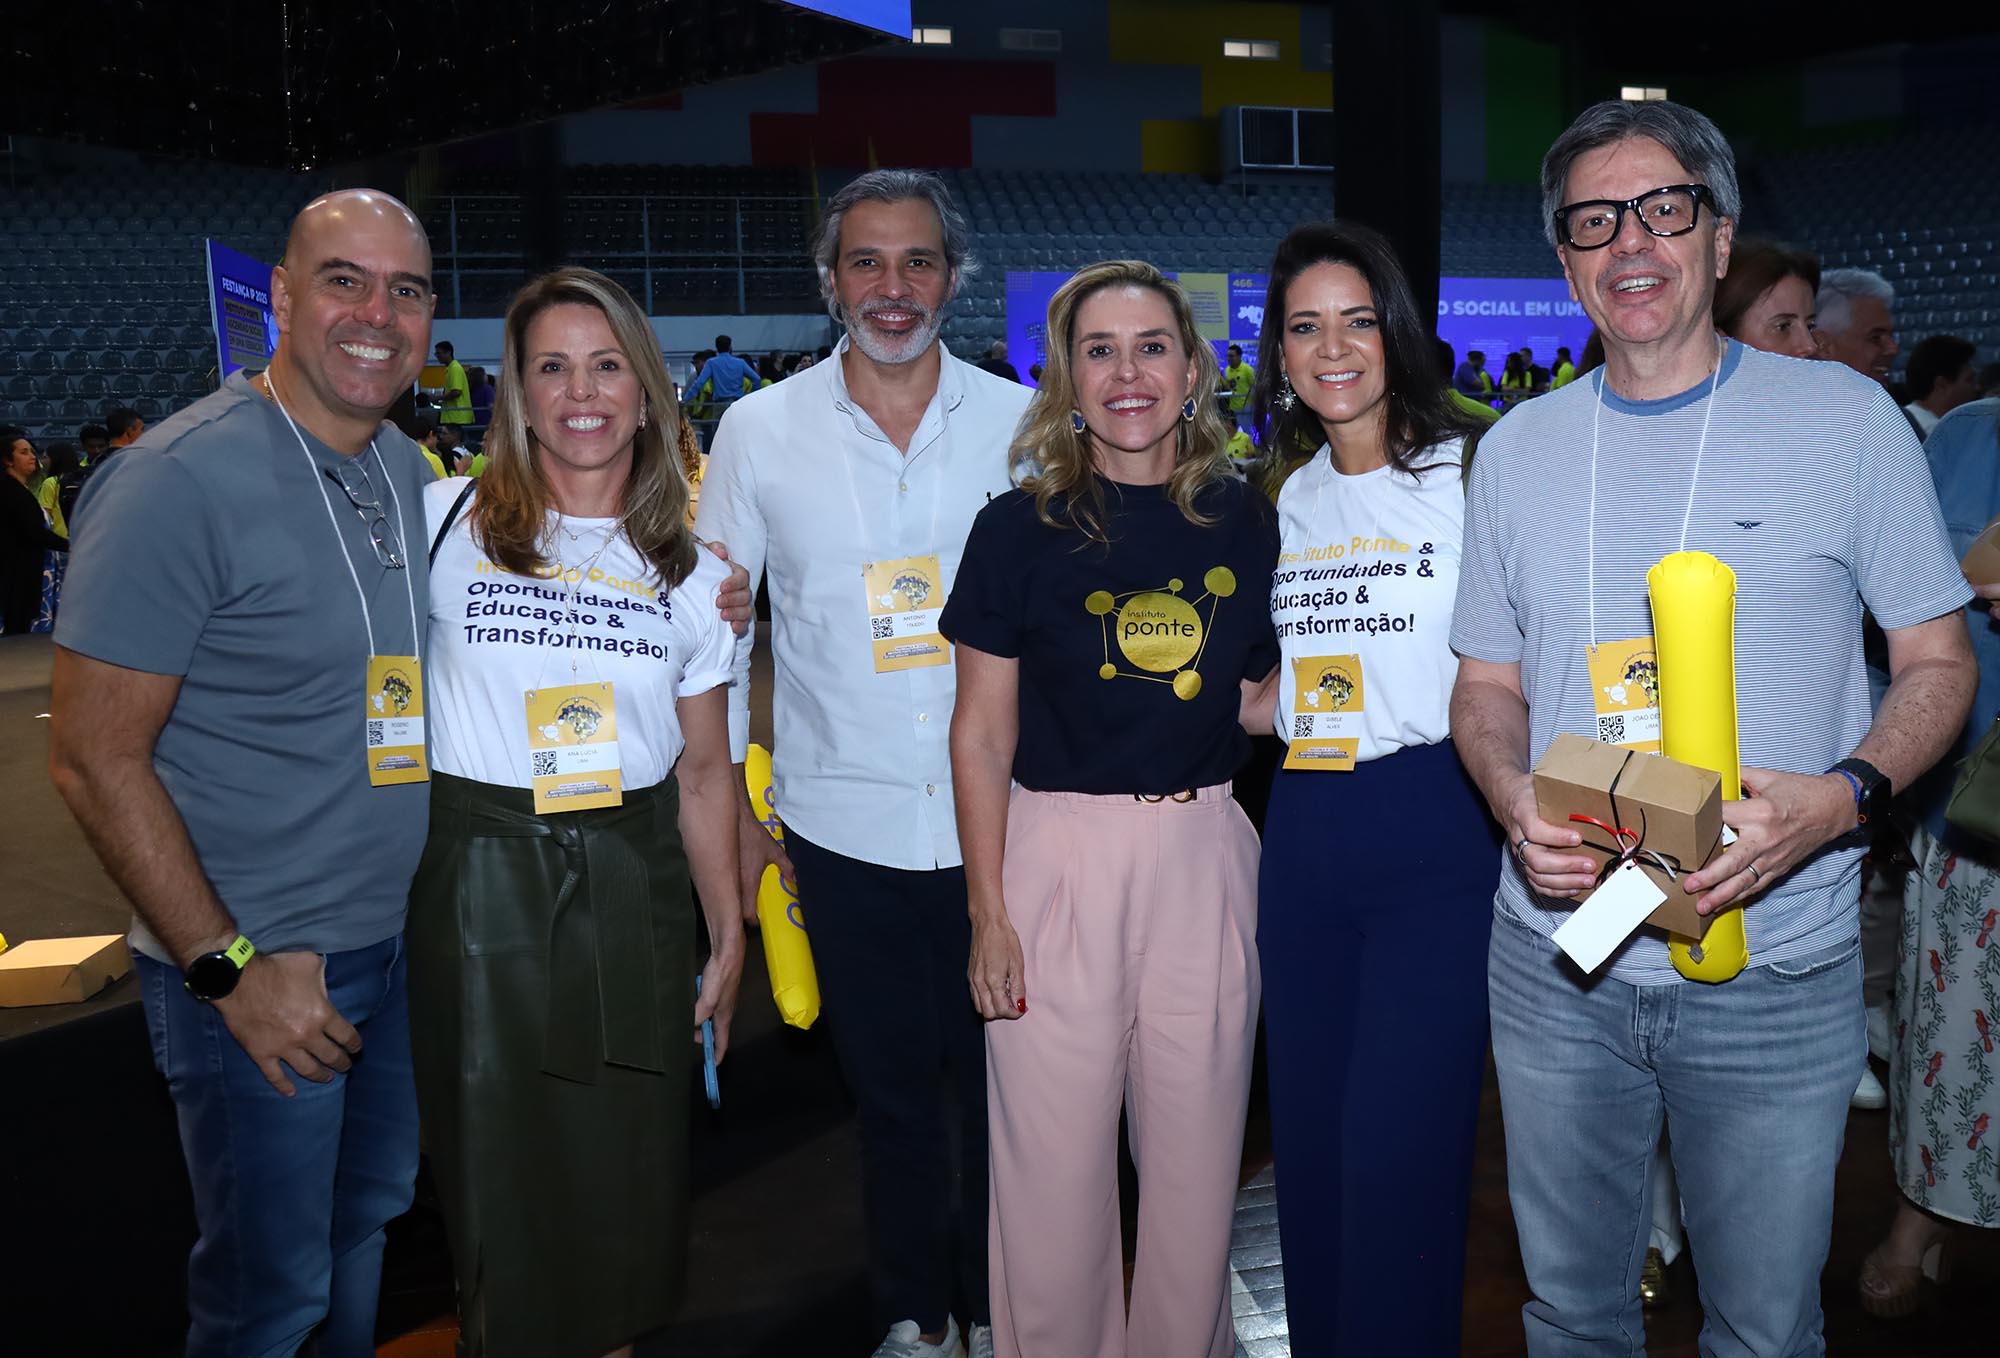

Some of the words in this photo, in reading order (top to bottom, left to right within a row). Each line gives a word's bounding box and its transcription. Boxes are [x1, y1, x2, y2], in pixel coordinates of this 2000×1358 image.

[222, 277, 250, 299] FESTANÇA
[250, 287, 256, 299] IP
[256, 290, 268, 305] 2025
[1233, 279, 1253, 288] 466
[1453, 300, 1520, 316] SOCIAL
[1525, 301, 1551, 316] EM
[1351, 535, 1410, 557] Ponte
[1419, 542, 1434, 554] &
[1417, 559, 1434, 578] &
[589, 568, 657, 600] Ponte
[658, 592, 671, 610] &
[1271, 587, 1347, 612] ducação
[1355, 585, 1369, 604] &
[466, 600, 597, 626] Educação
[607, 614, 625, 629] &
[1127, 610, 1166, 618] instituto
[1276, 613, 1414, 638] ansformação!
[1125, 619, 1195, 640] ponte
[464, 625, 668, 662] Transformação!
